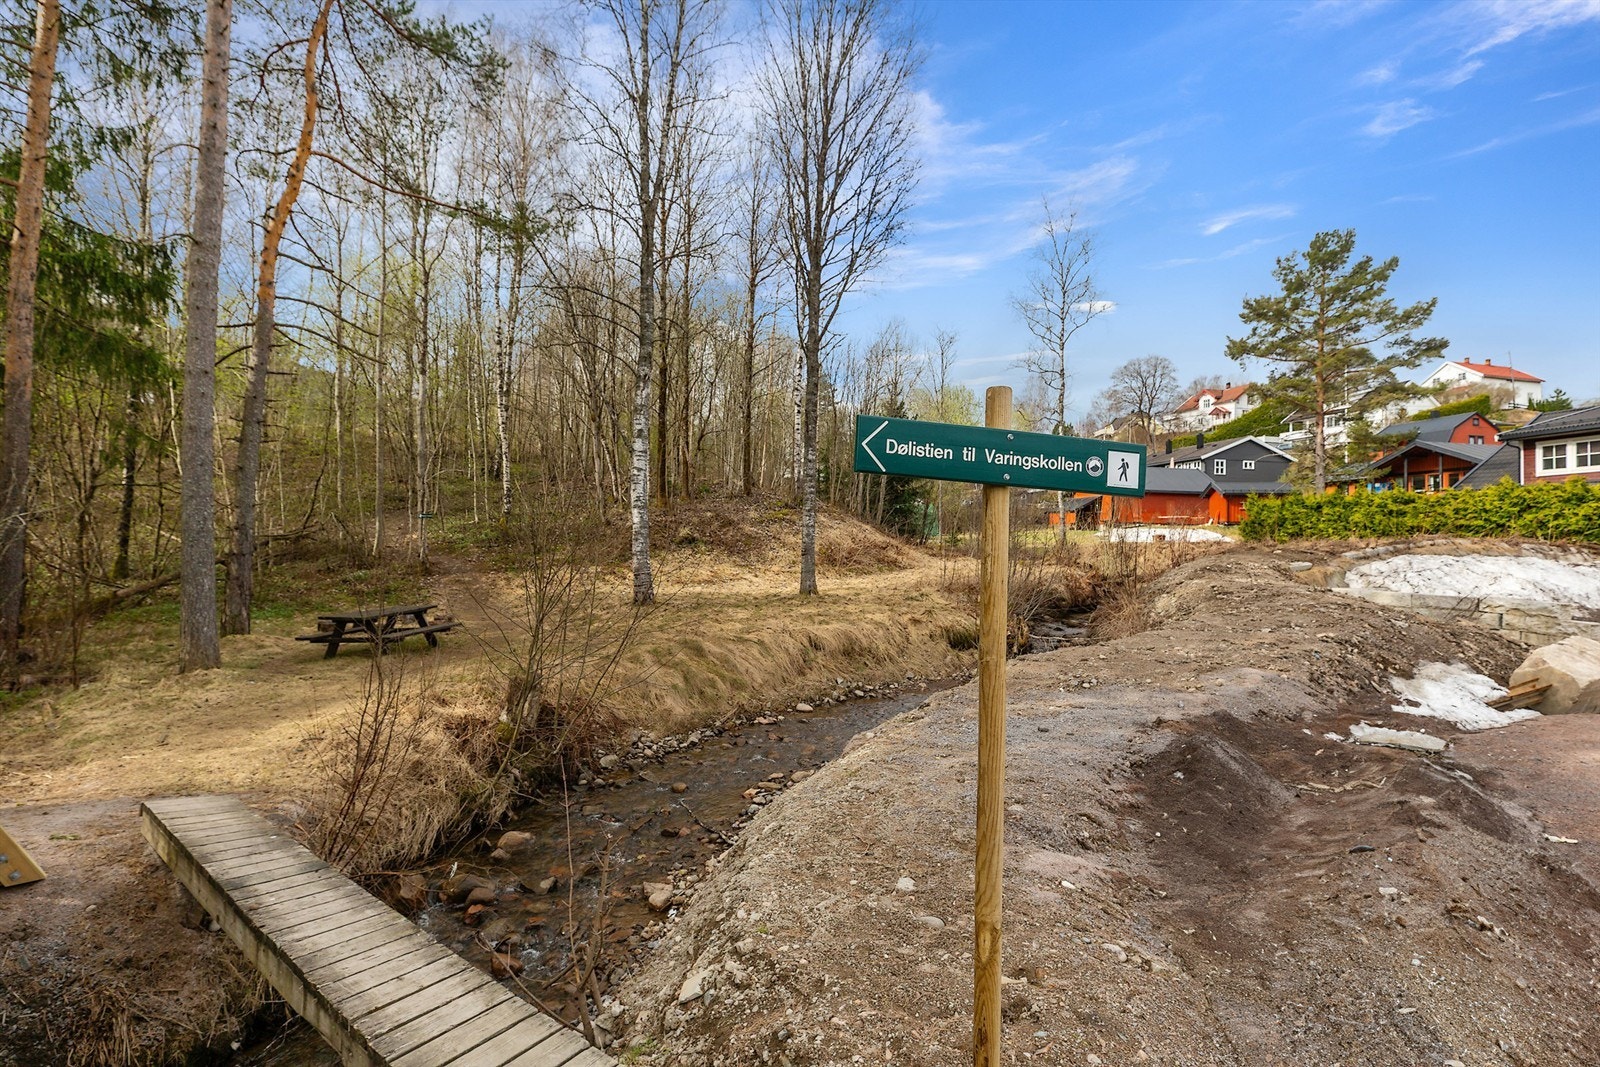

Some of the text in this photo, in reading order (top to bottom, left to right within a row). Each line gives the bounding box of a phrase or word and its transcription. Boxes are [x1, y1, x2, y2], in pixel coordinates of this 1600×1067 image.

[885, 438, 953, 460] Dølistien
[962, 446, 976, 462] til
[984, 448, 1083, 473] Varingskollen
